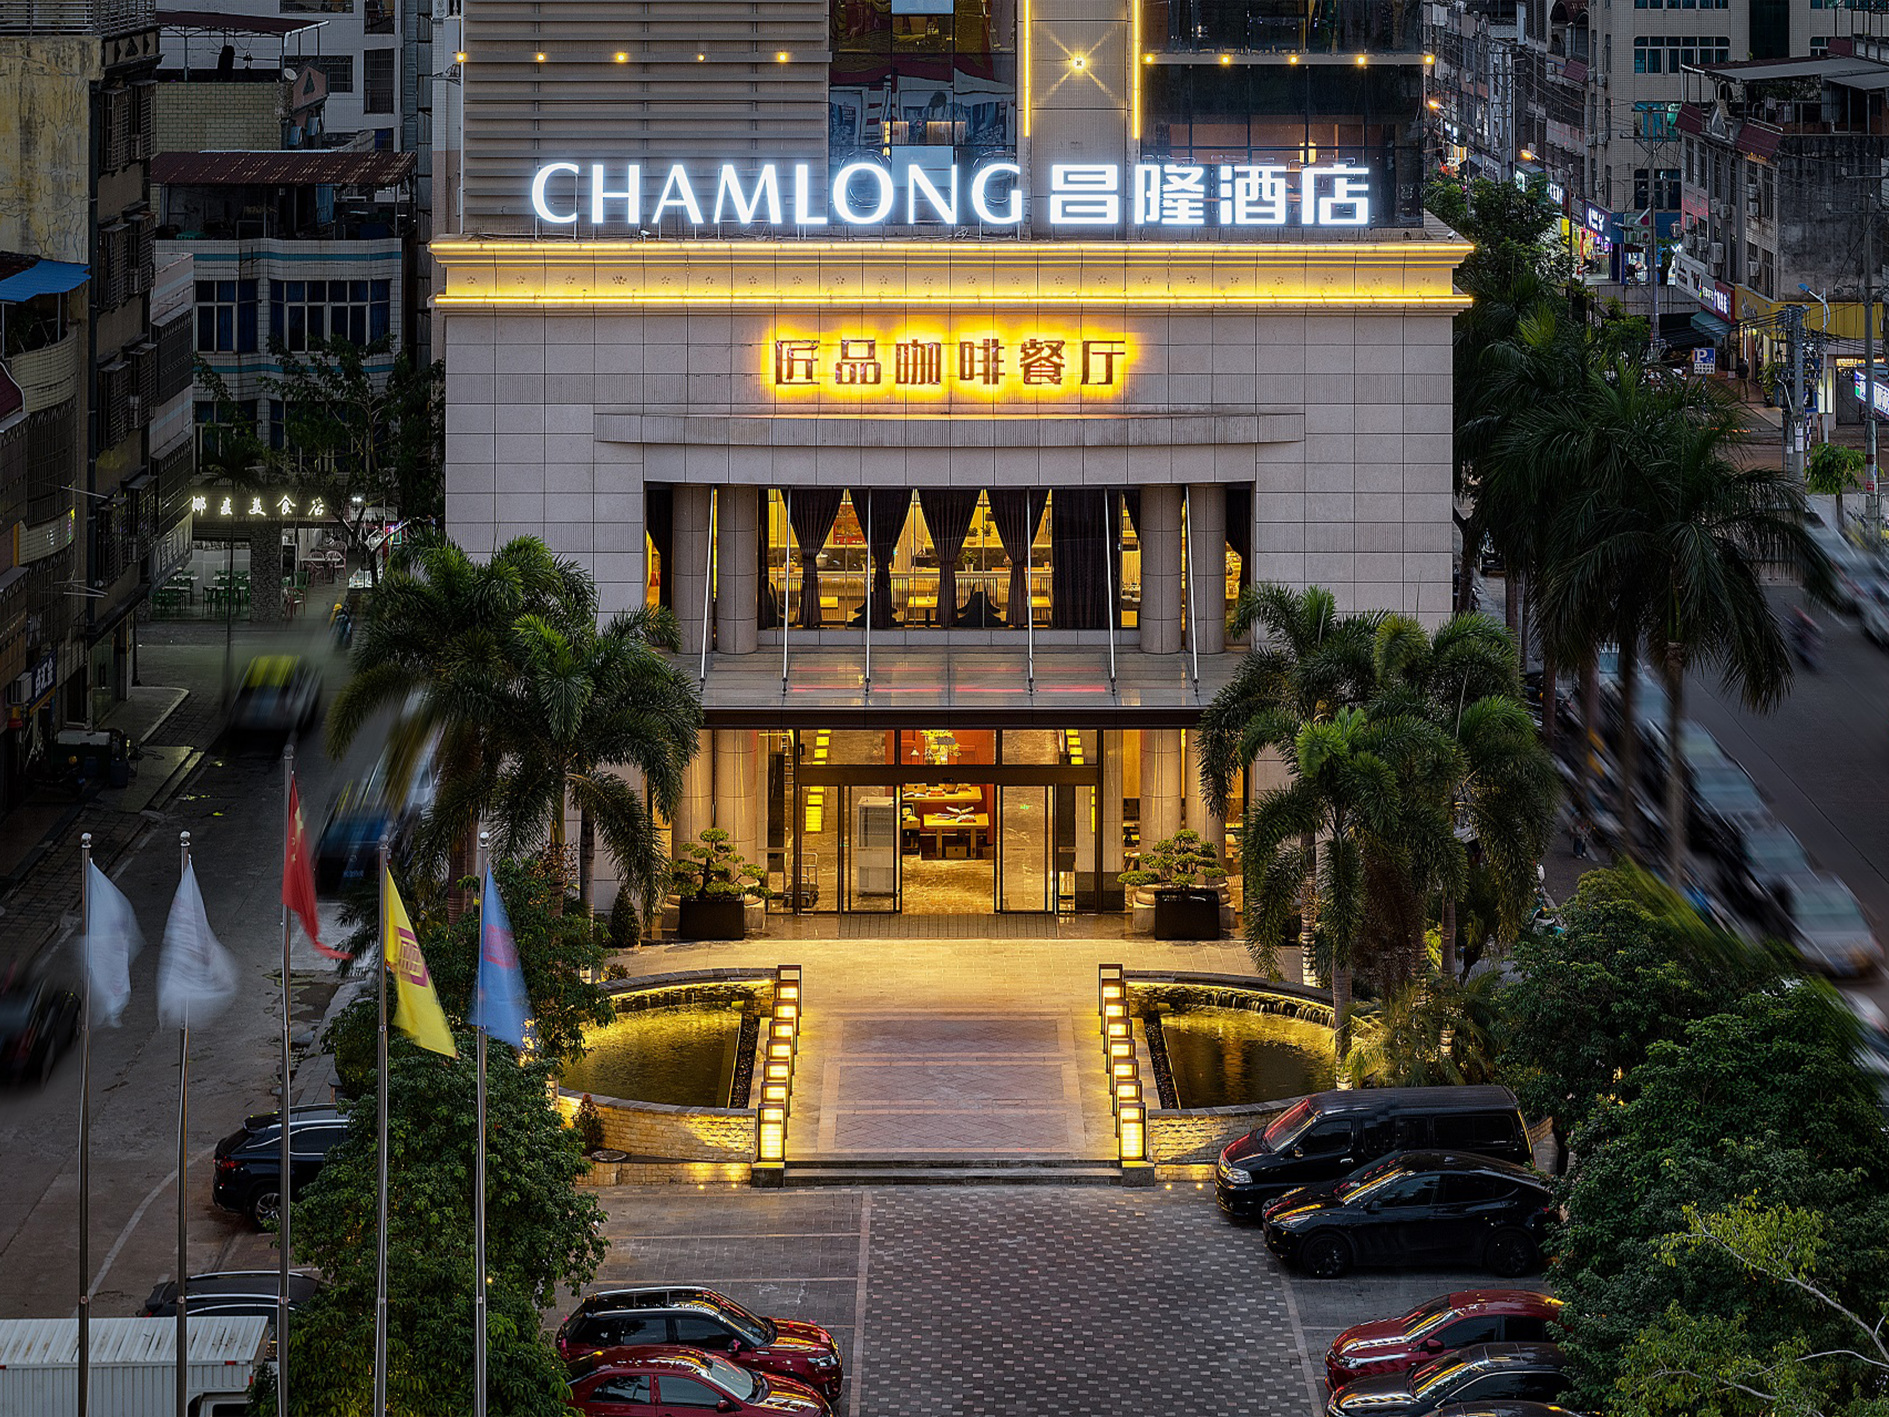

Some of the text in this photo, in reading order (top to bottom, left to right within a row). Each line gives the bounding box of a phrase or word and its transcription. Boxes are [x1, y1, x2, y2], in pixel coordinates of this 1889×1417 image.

[530, 161, 1371, 229] CHAMLONG 昌隆酒店
[775, 338, 1126, 385] 匠品咖啡餐厅
[1695, 349, 1708, 363] P
